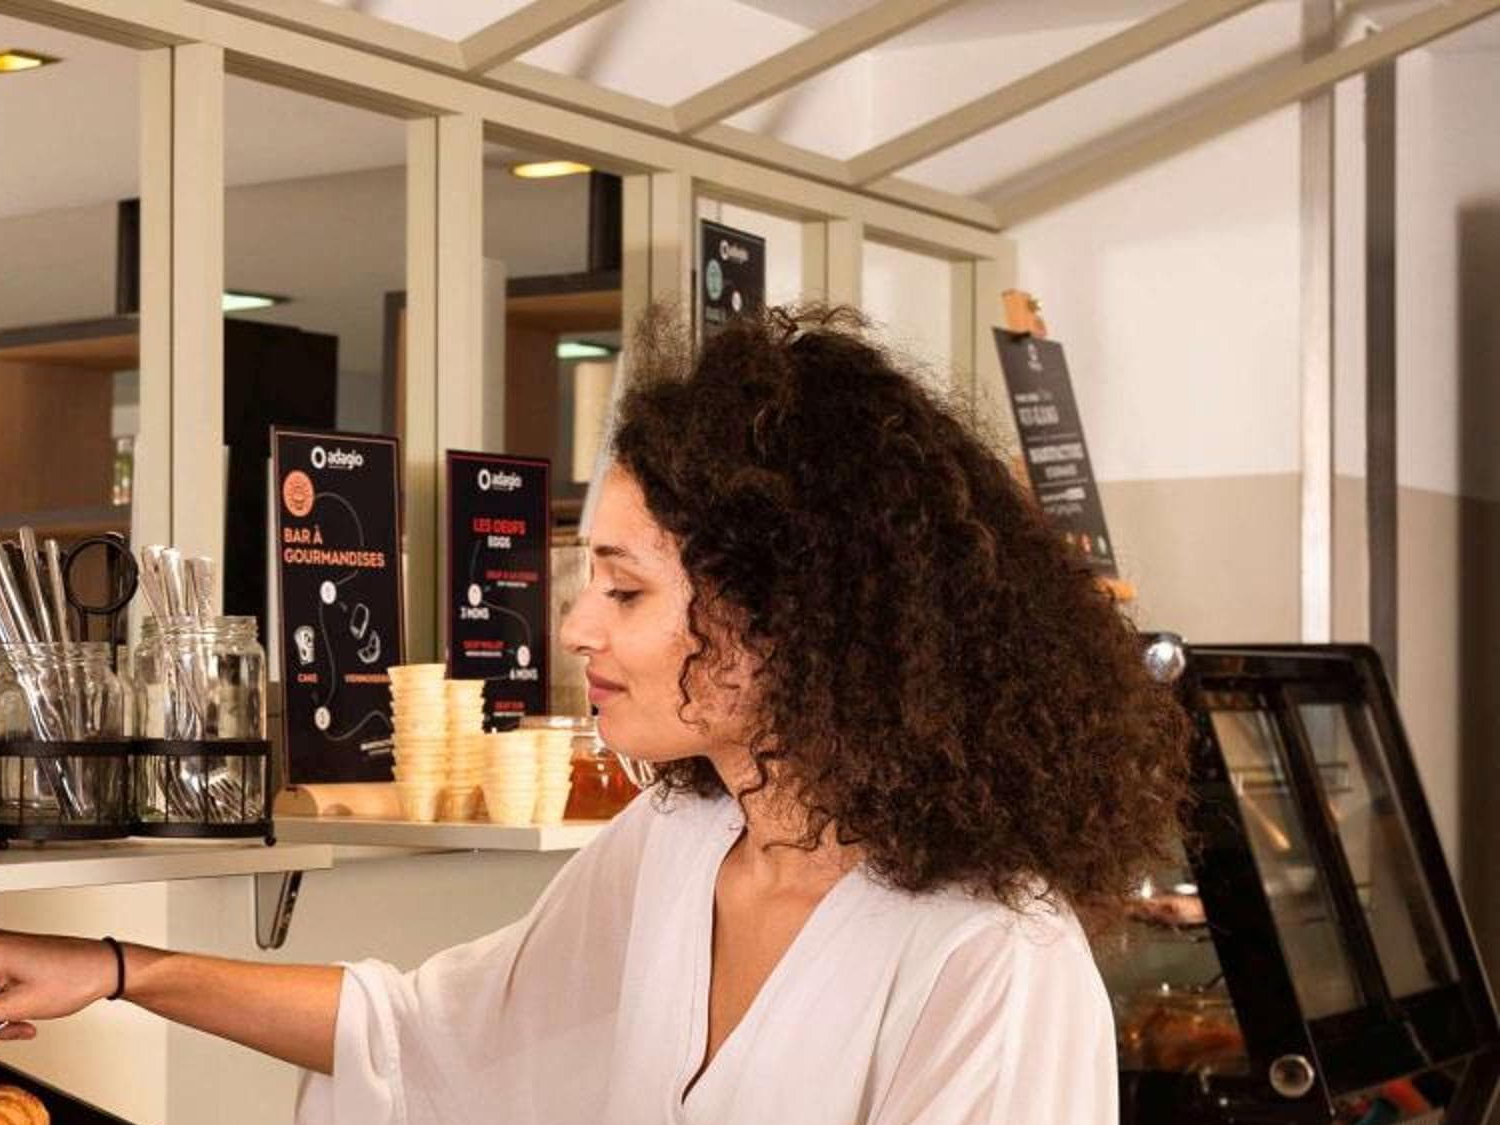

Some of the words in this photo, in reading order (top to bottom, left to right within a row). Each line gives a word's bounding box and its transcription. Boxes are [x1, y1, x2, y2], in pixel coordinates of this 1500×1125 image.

[328, 448, 363, 469] adagio
[284, 528, 311, 543] BAR
[313, 525, 323, 544] À
[284, 549, 385, 567] GOURMANDISES
